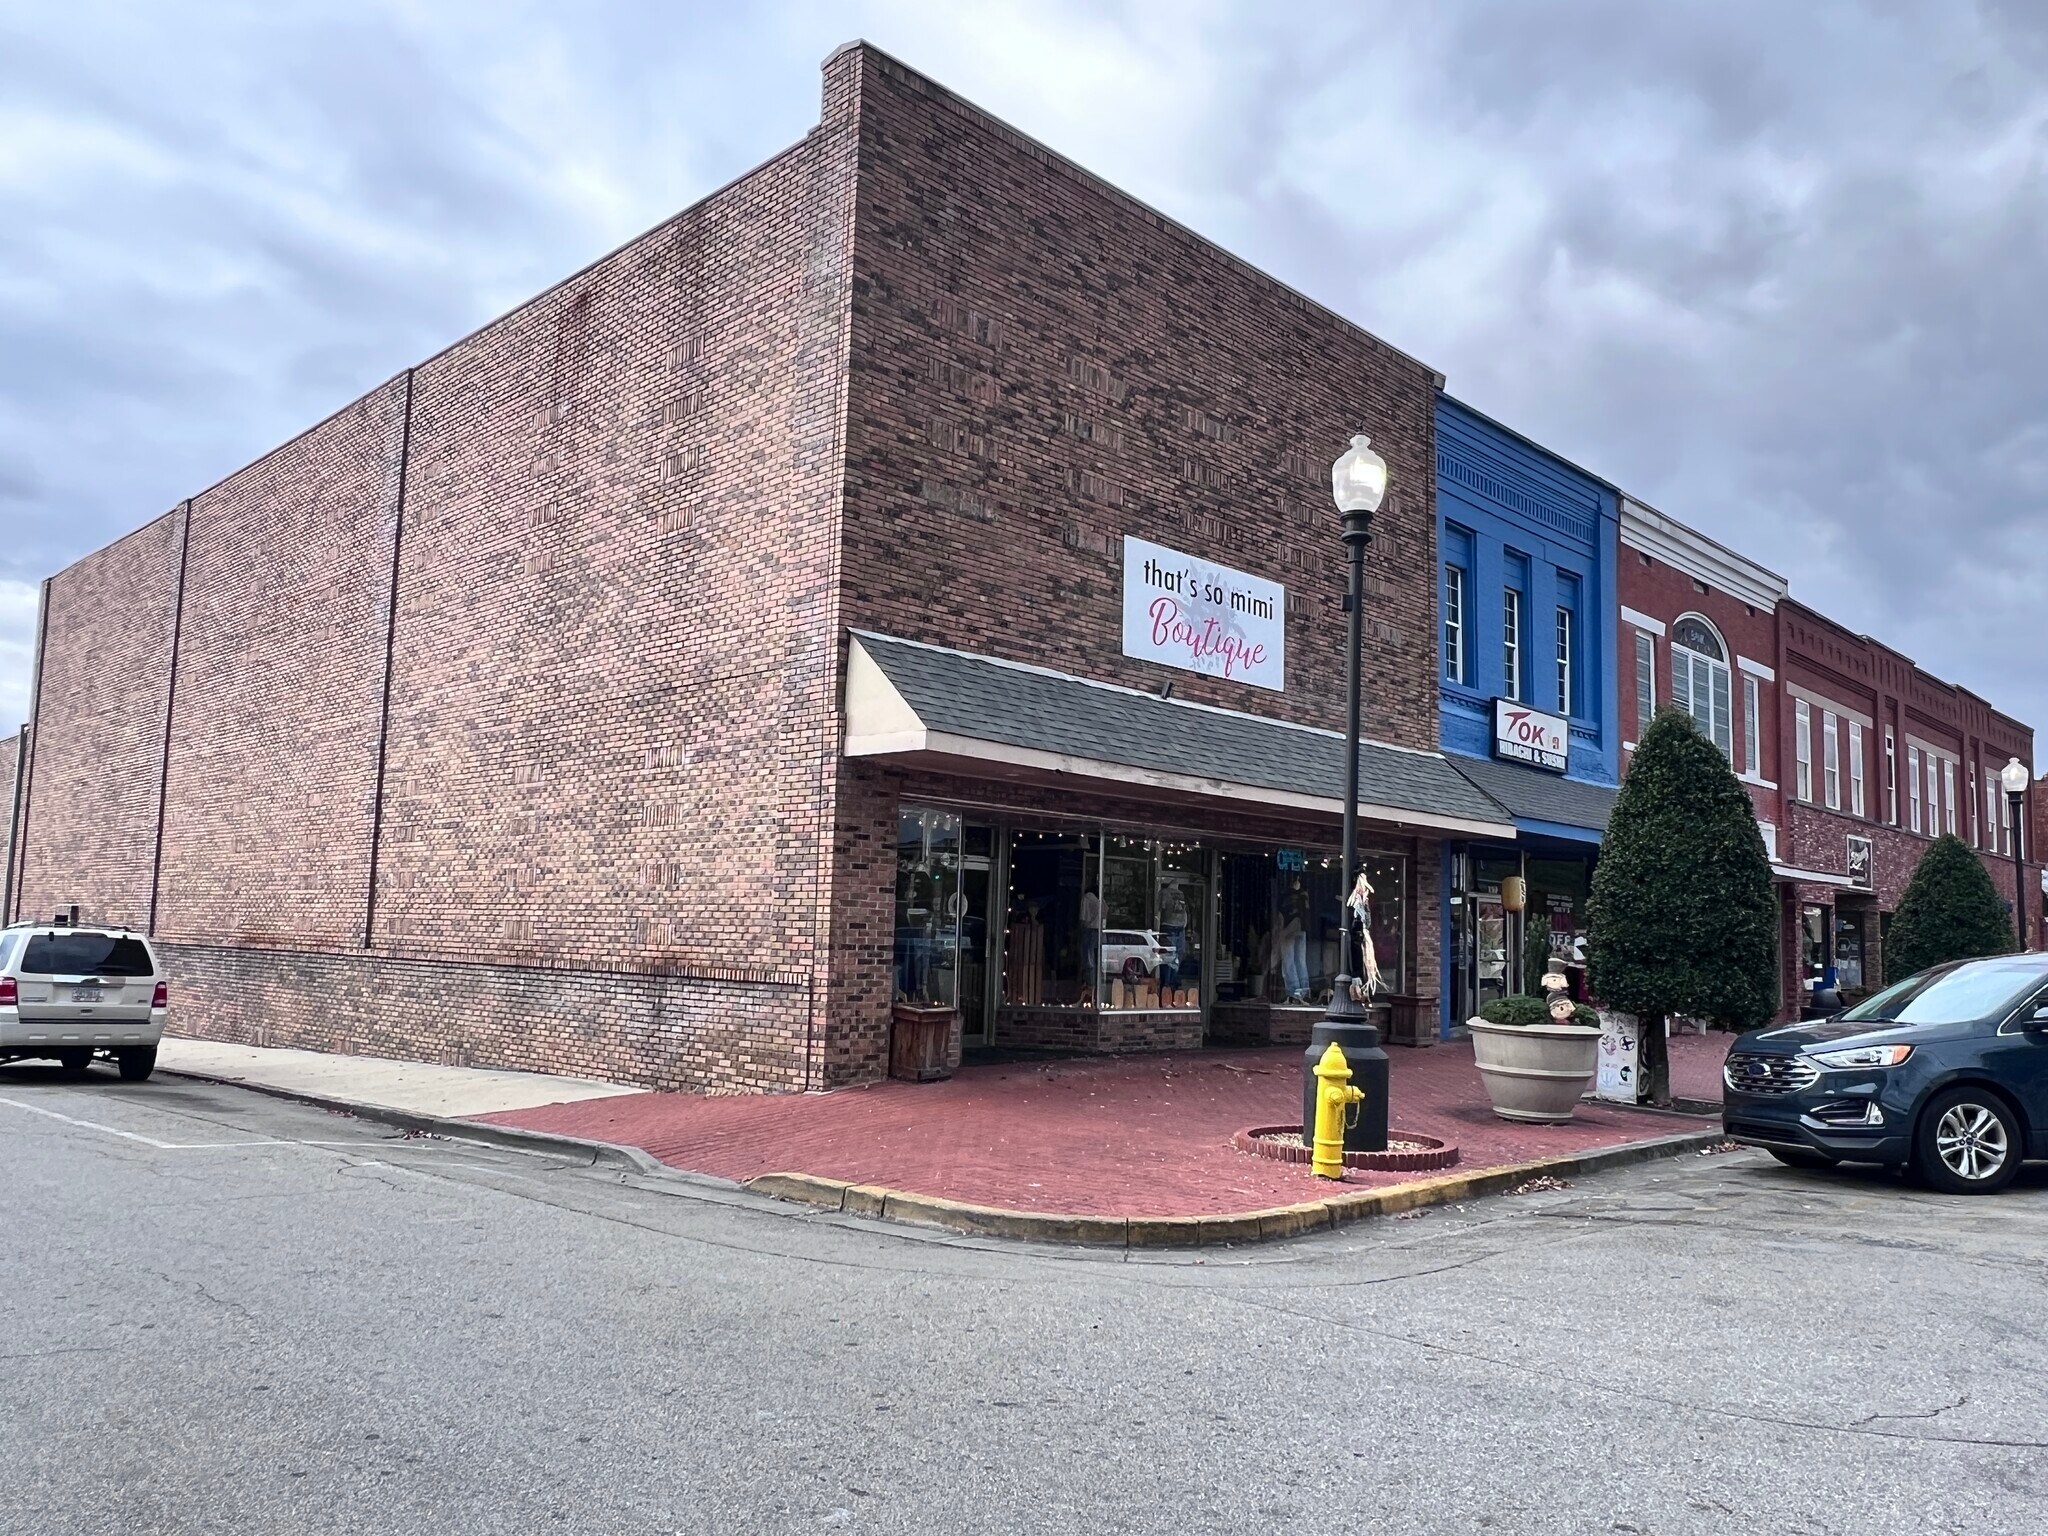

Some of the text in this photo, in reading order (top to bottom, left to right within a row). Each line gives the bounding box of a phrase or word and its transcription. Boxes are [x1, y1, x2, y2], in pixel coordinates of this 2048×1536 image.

[1144, 558, 1274, 620] that's so mimi
[1149, 597, 1268, 678] Boutique
